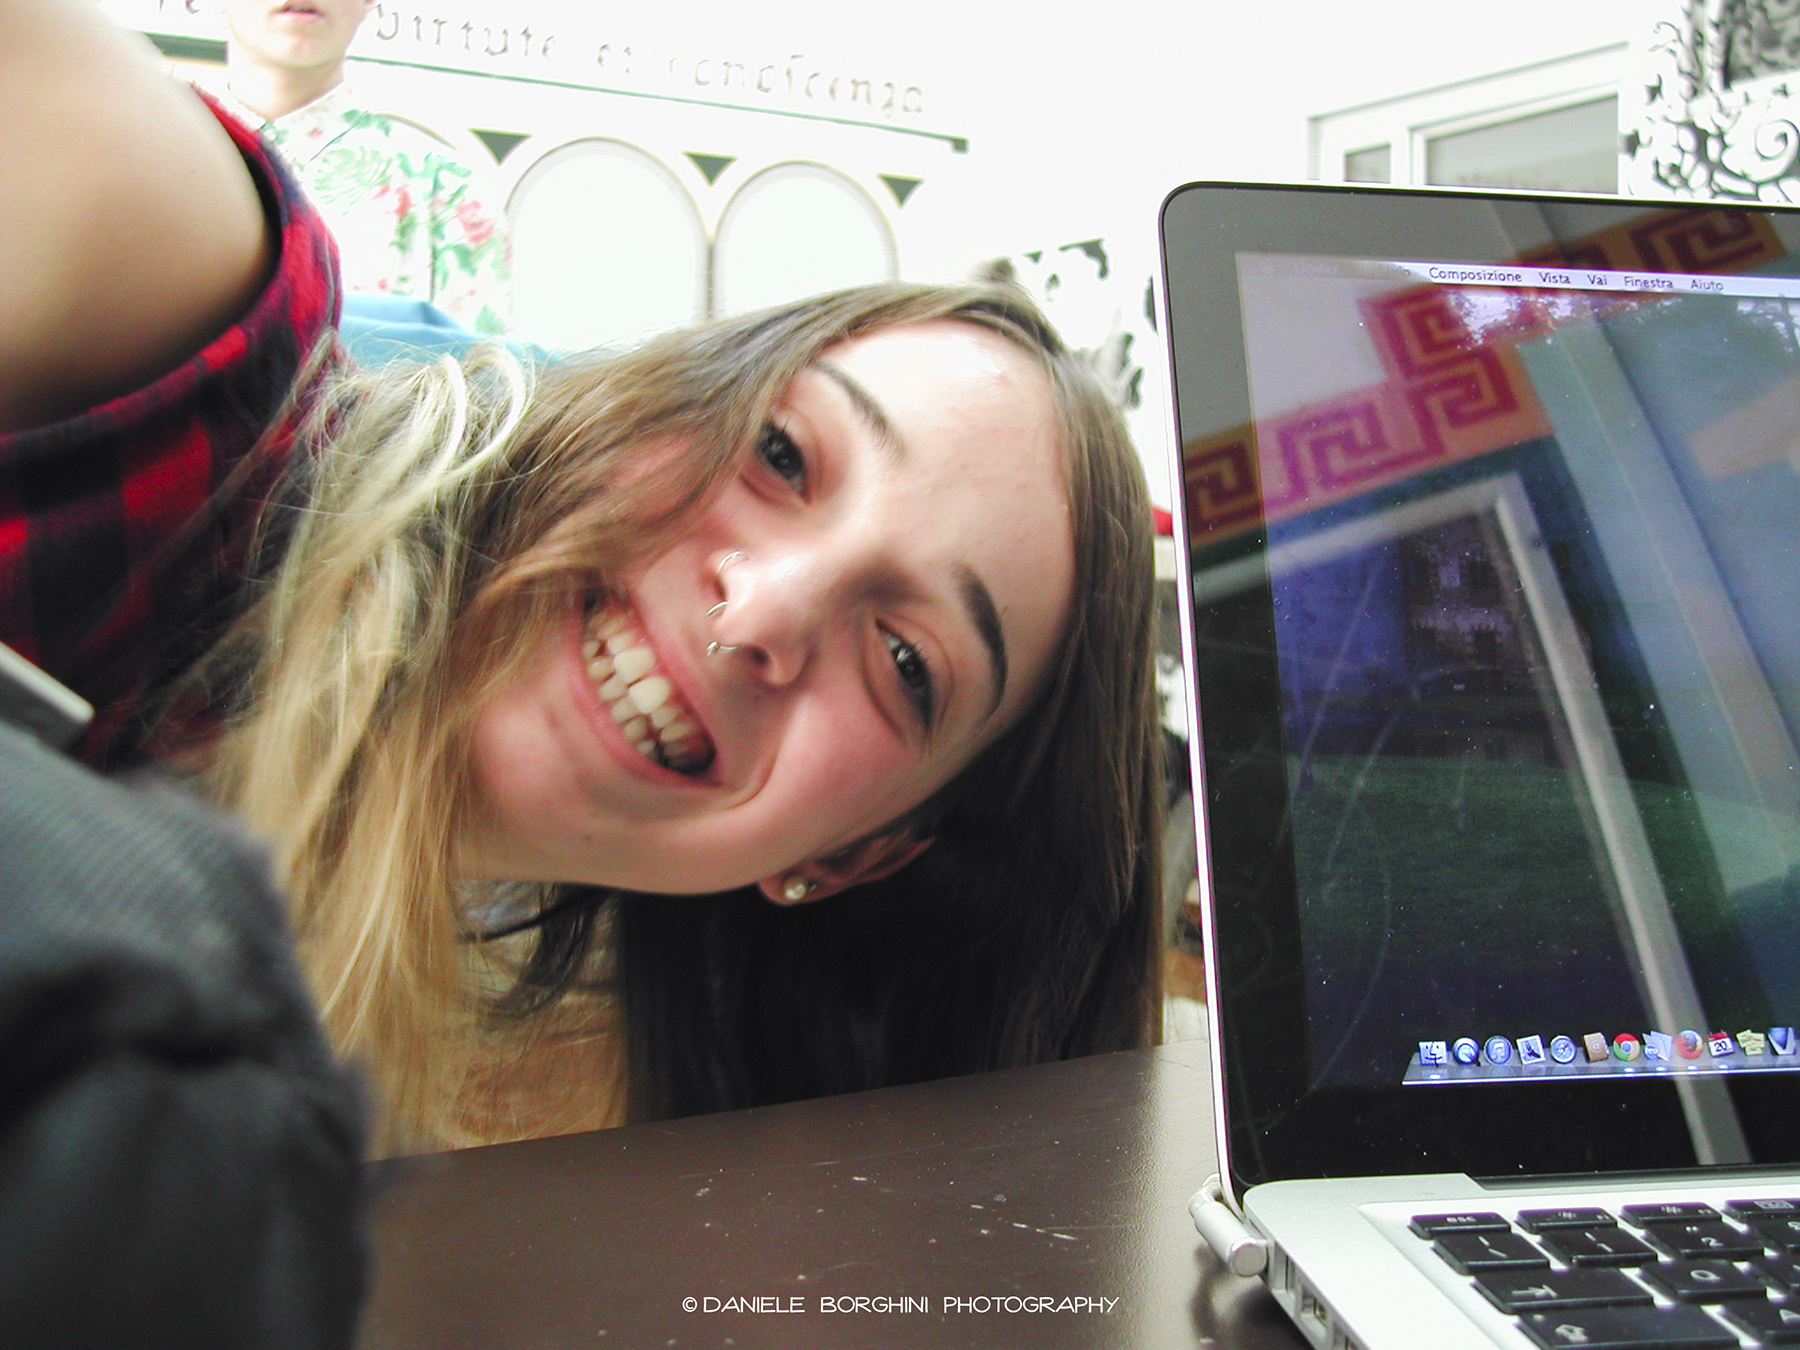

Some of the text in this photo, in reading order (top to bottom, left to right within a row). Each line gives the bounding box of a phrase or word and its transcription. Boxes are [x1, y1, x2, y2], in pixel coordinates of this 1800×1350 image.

[1429, 267, 1724, 292] Composizione Vista Vai Finestra Aiuto
[1713, 1040, 1728, 1053] 20
